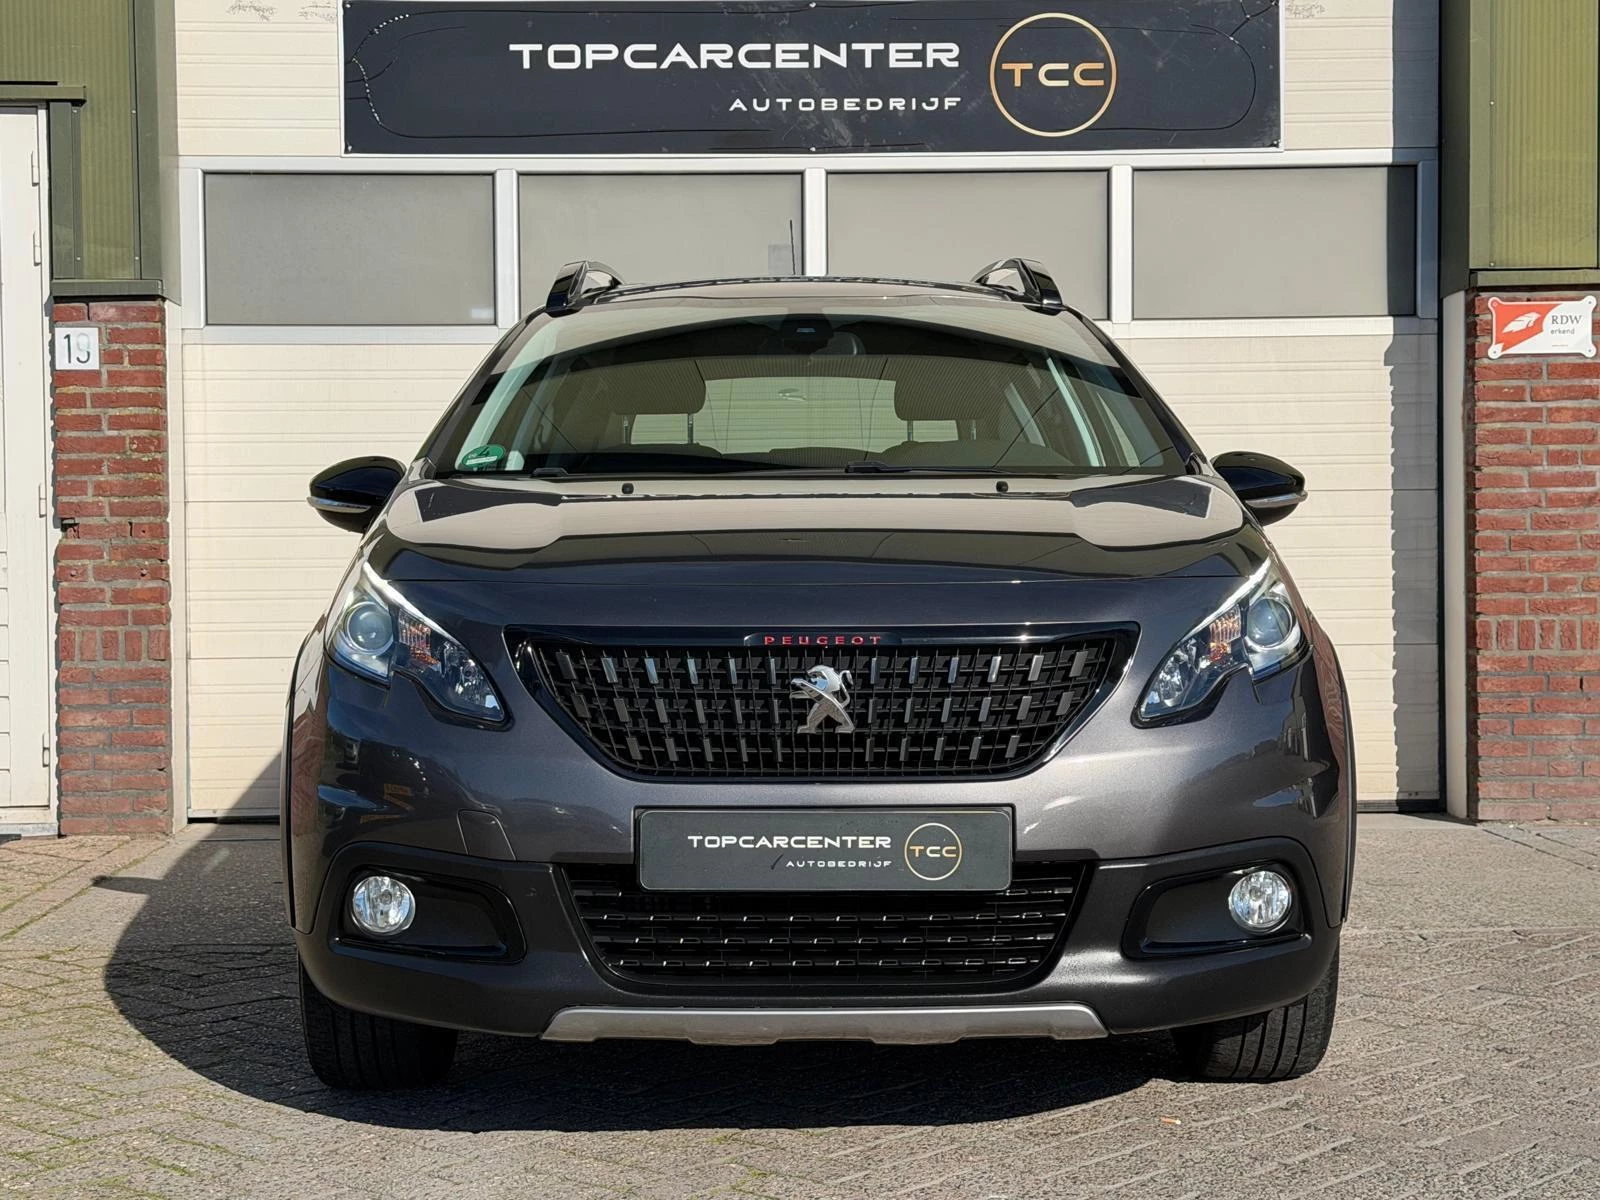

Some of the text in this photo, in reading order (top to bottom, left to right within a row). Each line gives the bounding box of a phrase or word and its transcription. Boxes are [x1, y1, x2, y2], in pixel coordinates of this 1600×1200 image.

[508, 42, 961, 70] TOPCARCENTER
[1001, 62, 1105, 87] TCC
[728, 97, 962, 112] AUTOBEDRIJF
[1551, 314, 1582, 325] RDW
[63, 332, 91, 365] 19
[764, 636, 882, 645] PEUGEOT
[687, 835, 892, 849] TOPCARCENTER
[909, 845, 957, 858] TCC
[785, 859, 893, 869] AUTOBEDRIJF
